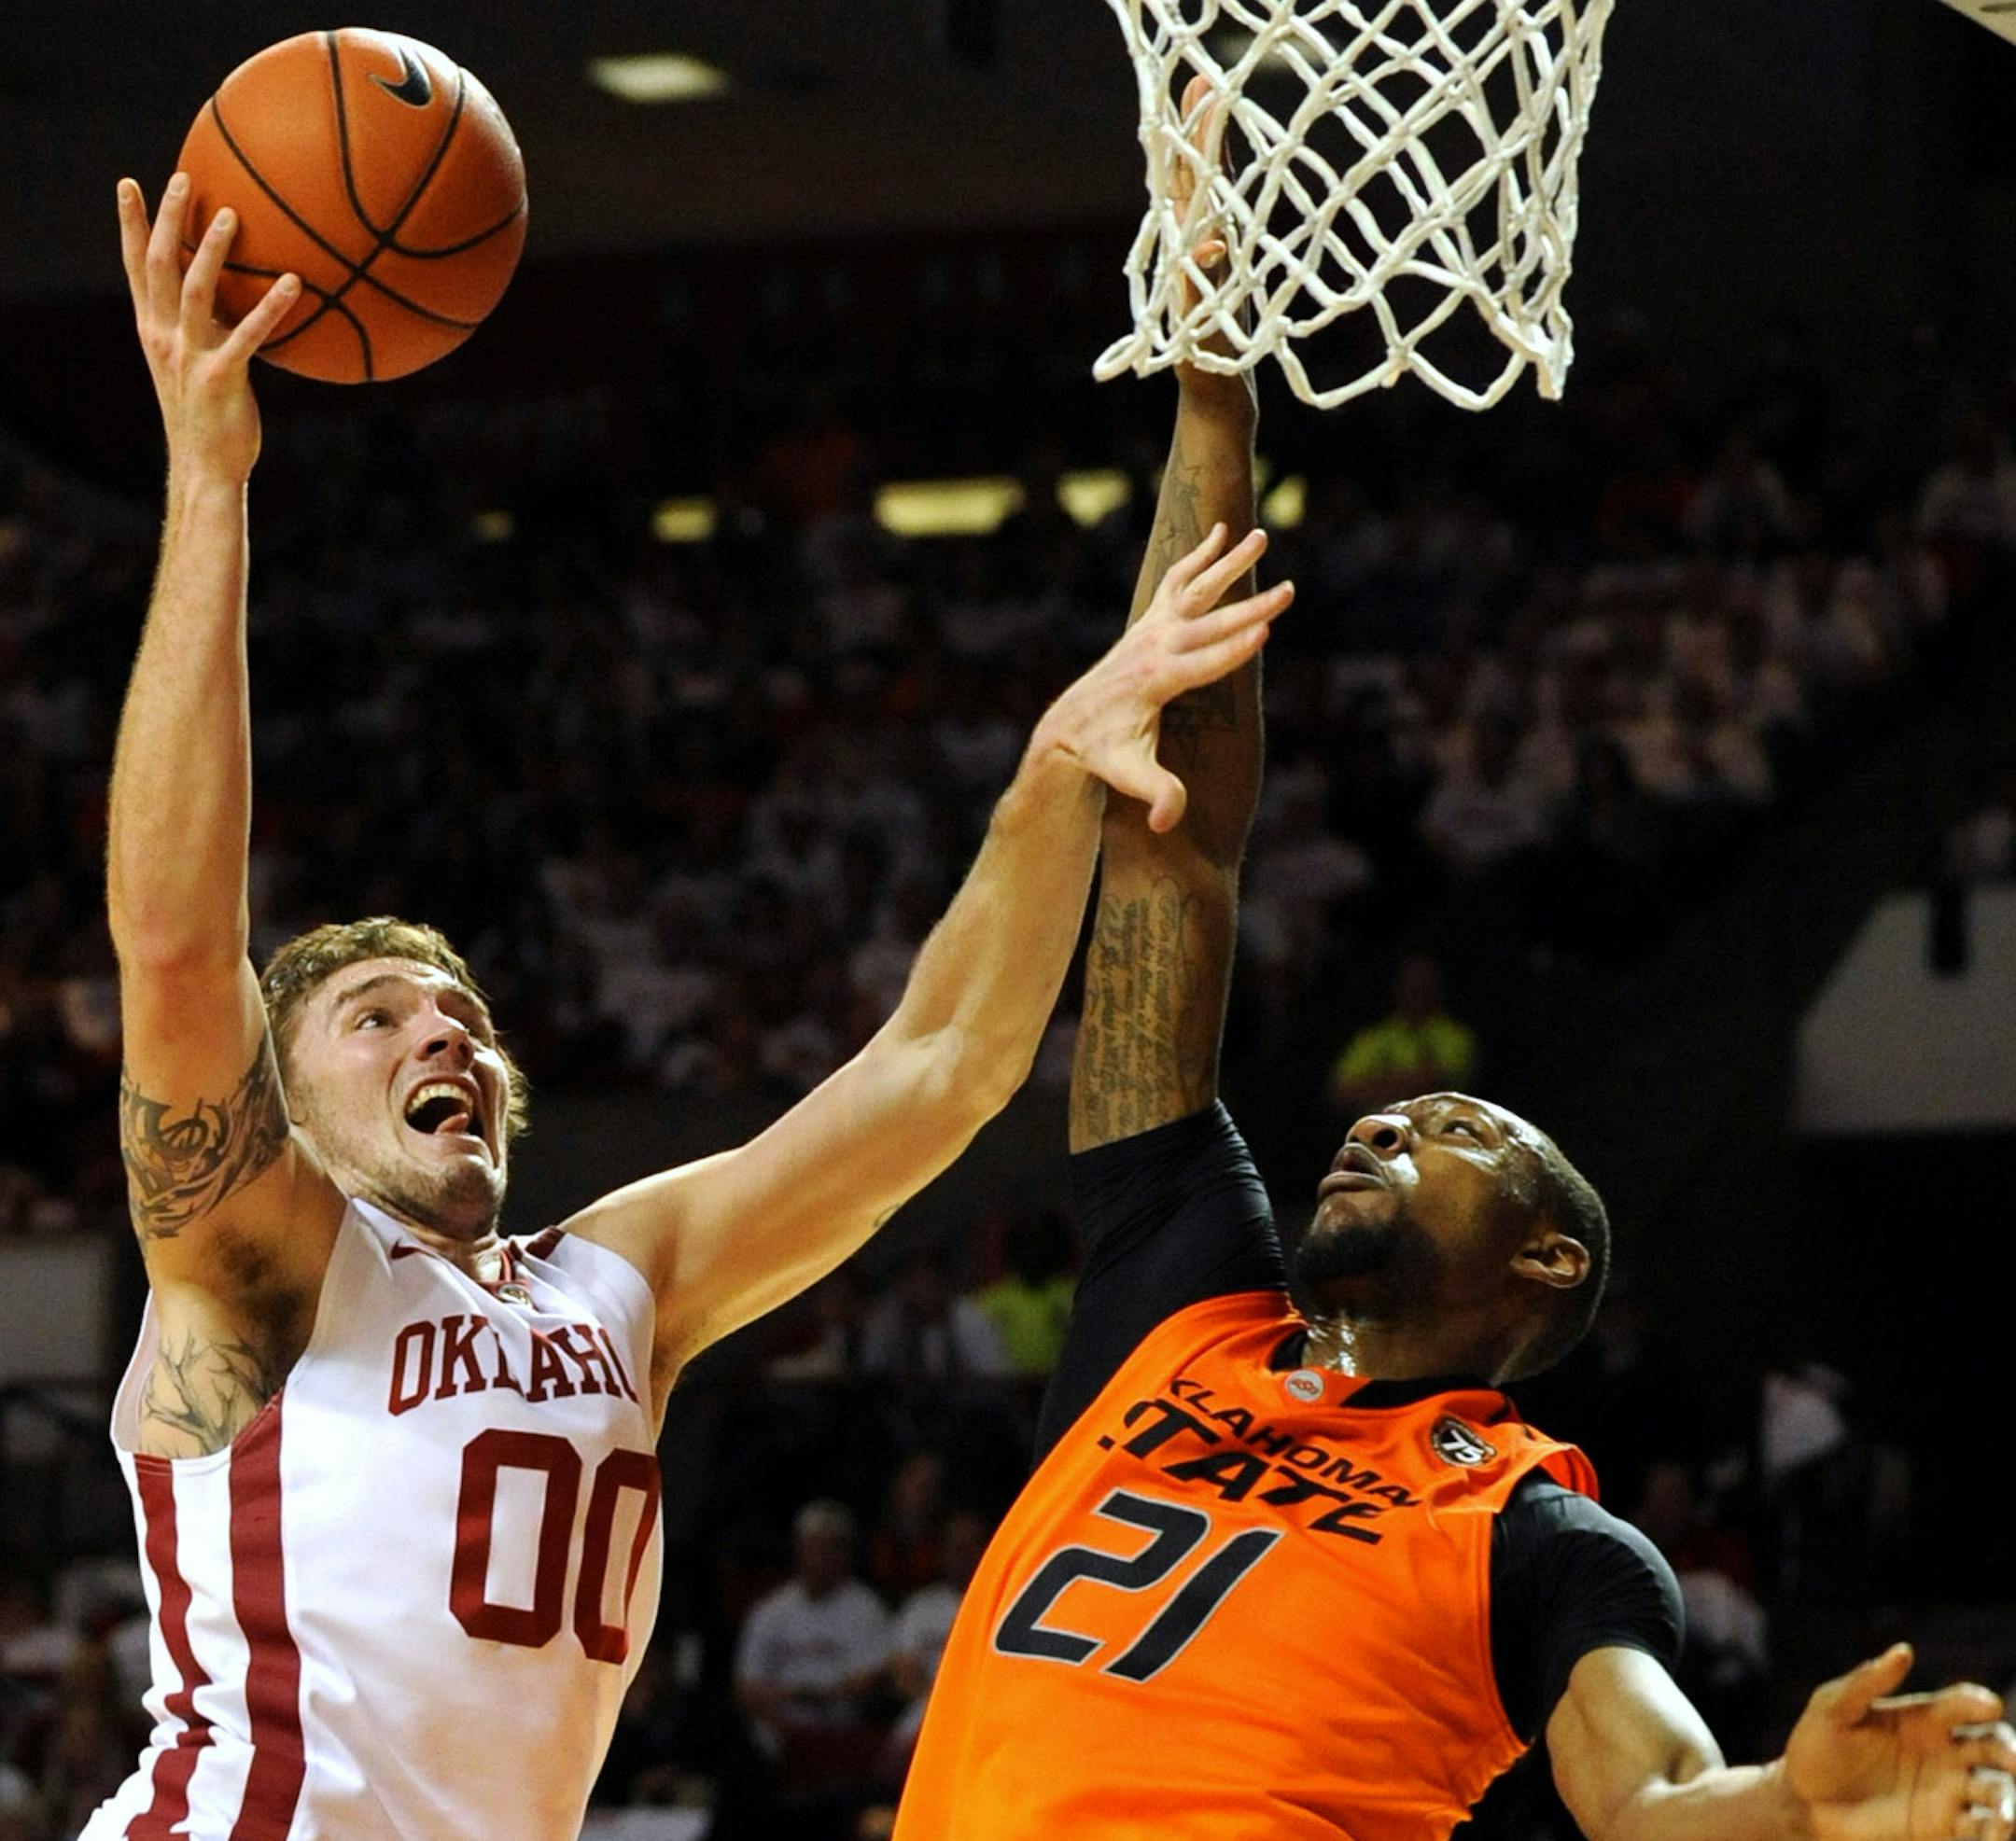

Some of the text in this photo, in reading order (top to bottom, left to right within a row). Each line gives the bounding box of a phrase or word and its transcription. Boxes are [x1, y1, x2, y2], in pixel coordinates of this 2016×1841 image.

[1440, 1429, 1485, 1464] 75
[448, 1428, 662, 1666] 00
[991, 1486, 1285, 1684] 21
